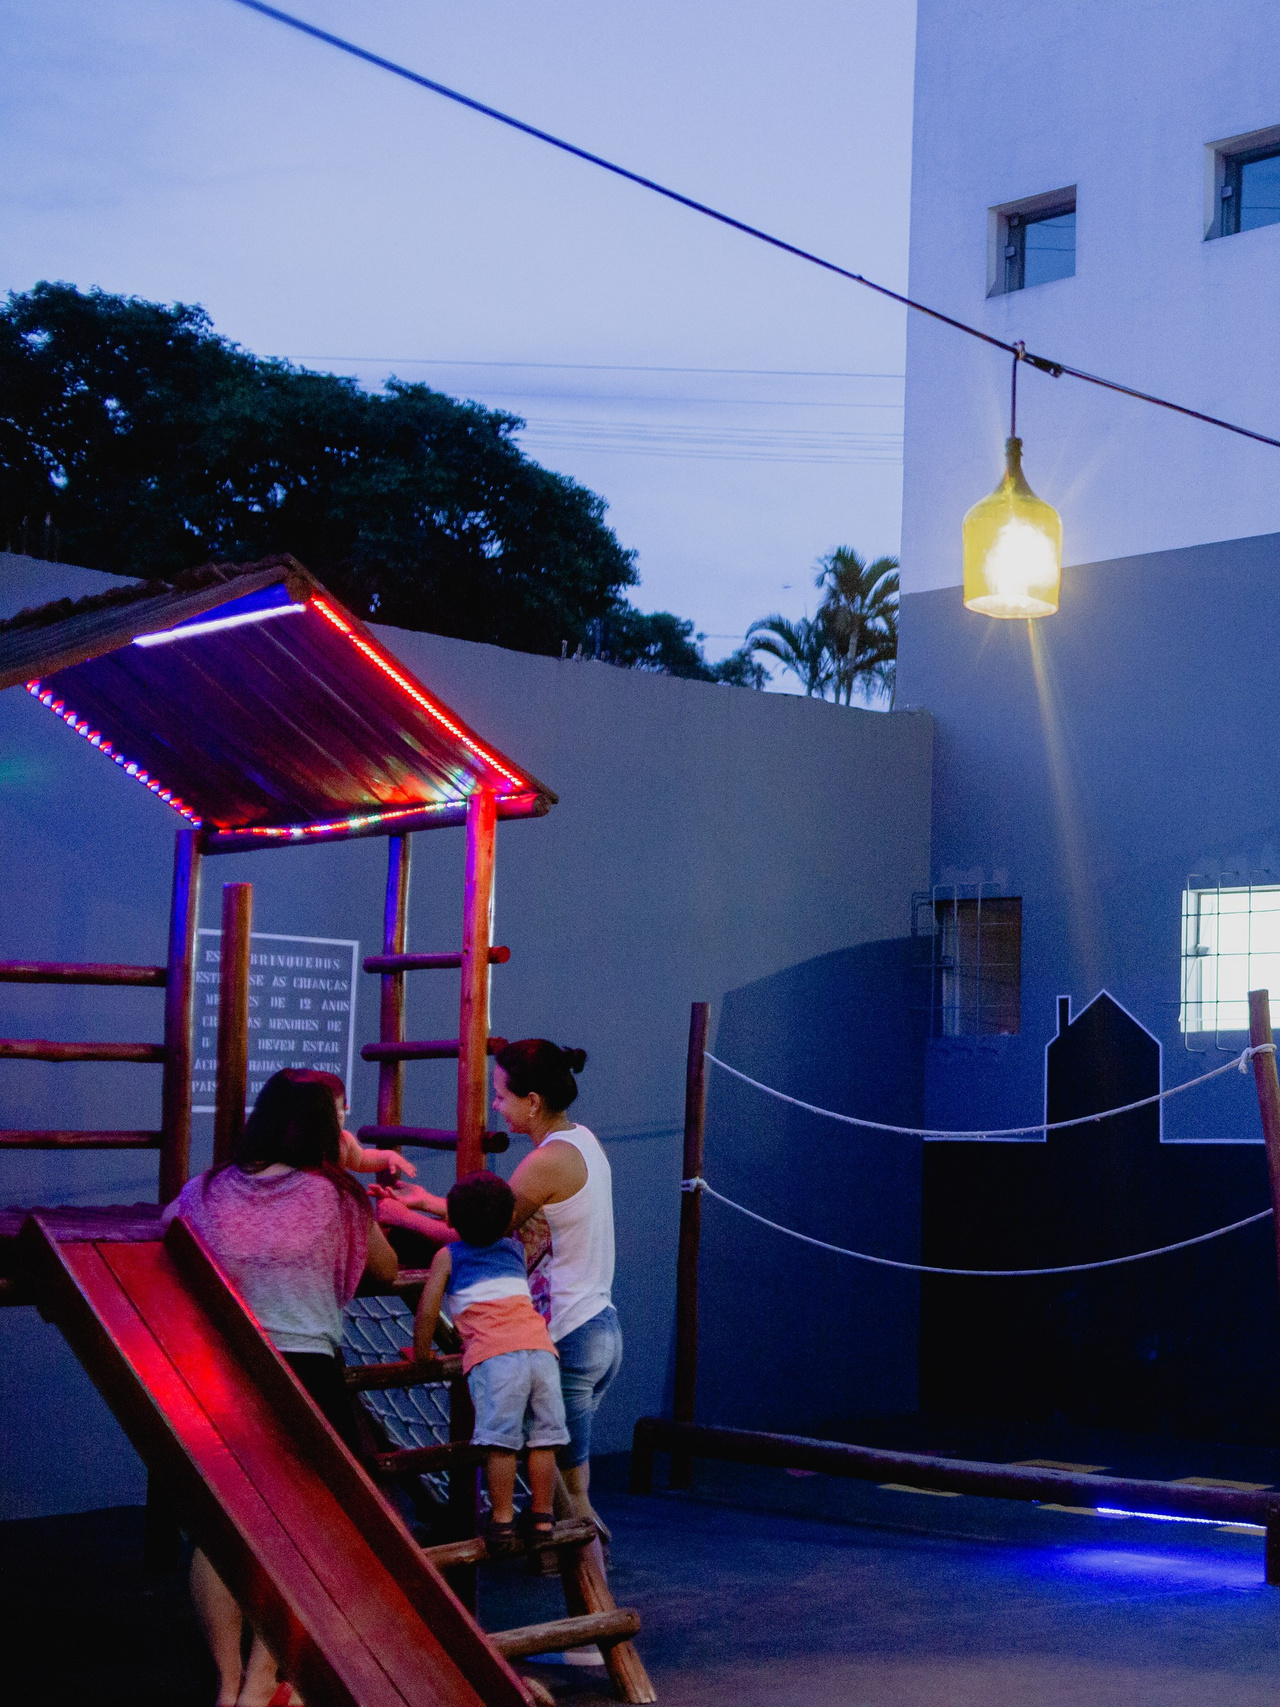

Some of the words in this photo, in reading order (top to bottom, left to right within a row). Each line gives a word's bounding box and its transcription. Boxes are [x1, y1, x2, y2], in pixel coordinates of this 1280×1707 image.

[250, 953, 341, 970] BRINQUEDOS
[270, 996, 286, 1009] DE
[321, 998, 350, 1012] ANOS
[268, 1018, 319, 1031] MENORES
[327, 1020, 342, 1032] DE
[258, 1038, 295, 1051] DEVEM
[302, 1040, 339, 1053] ESTAR
